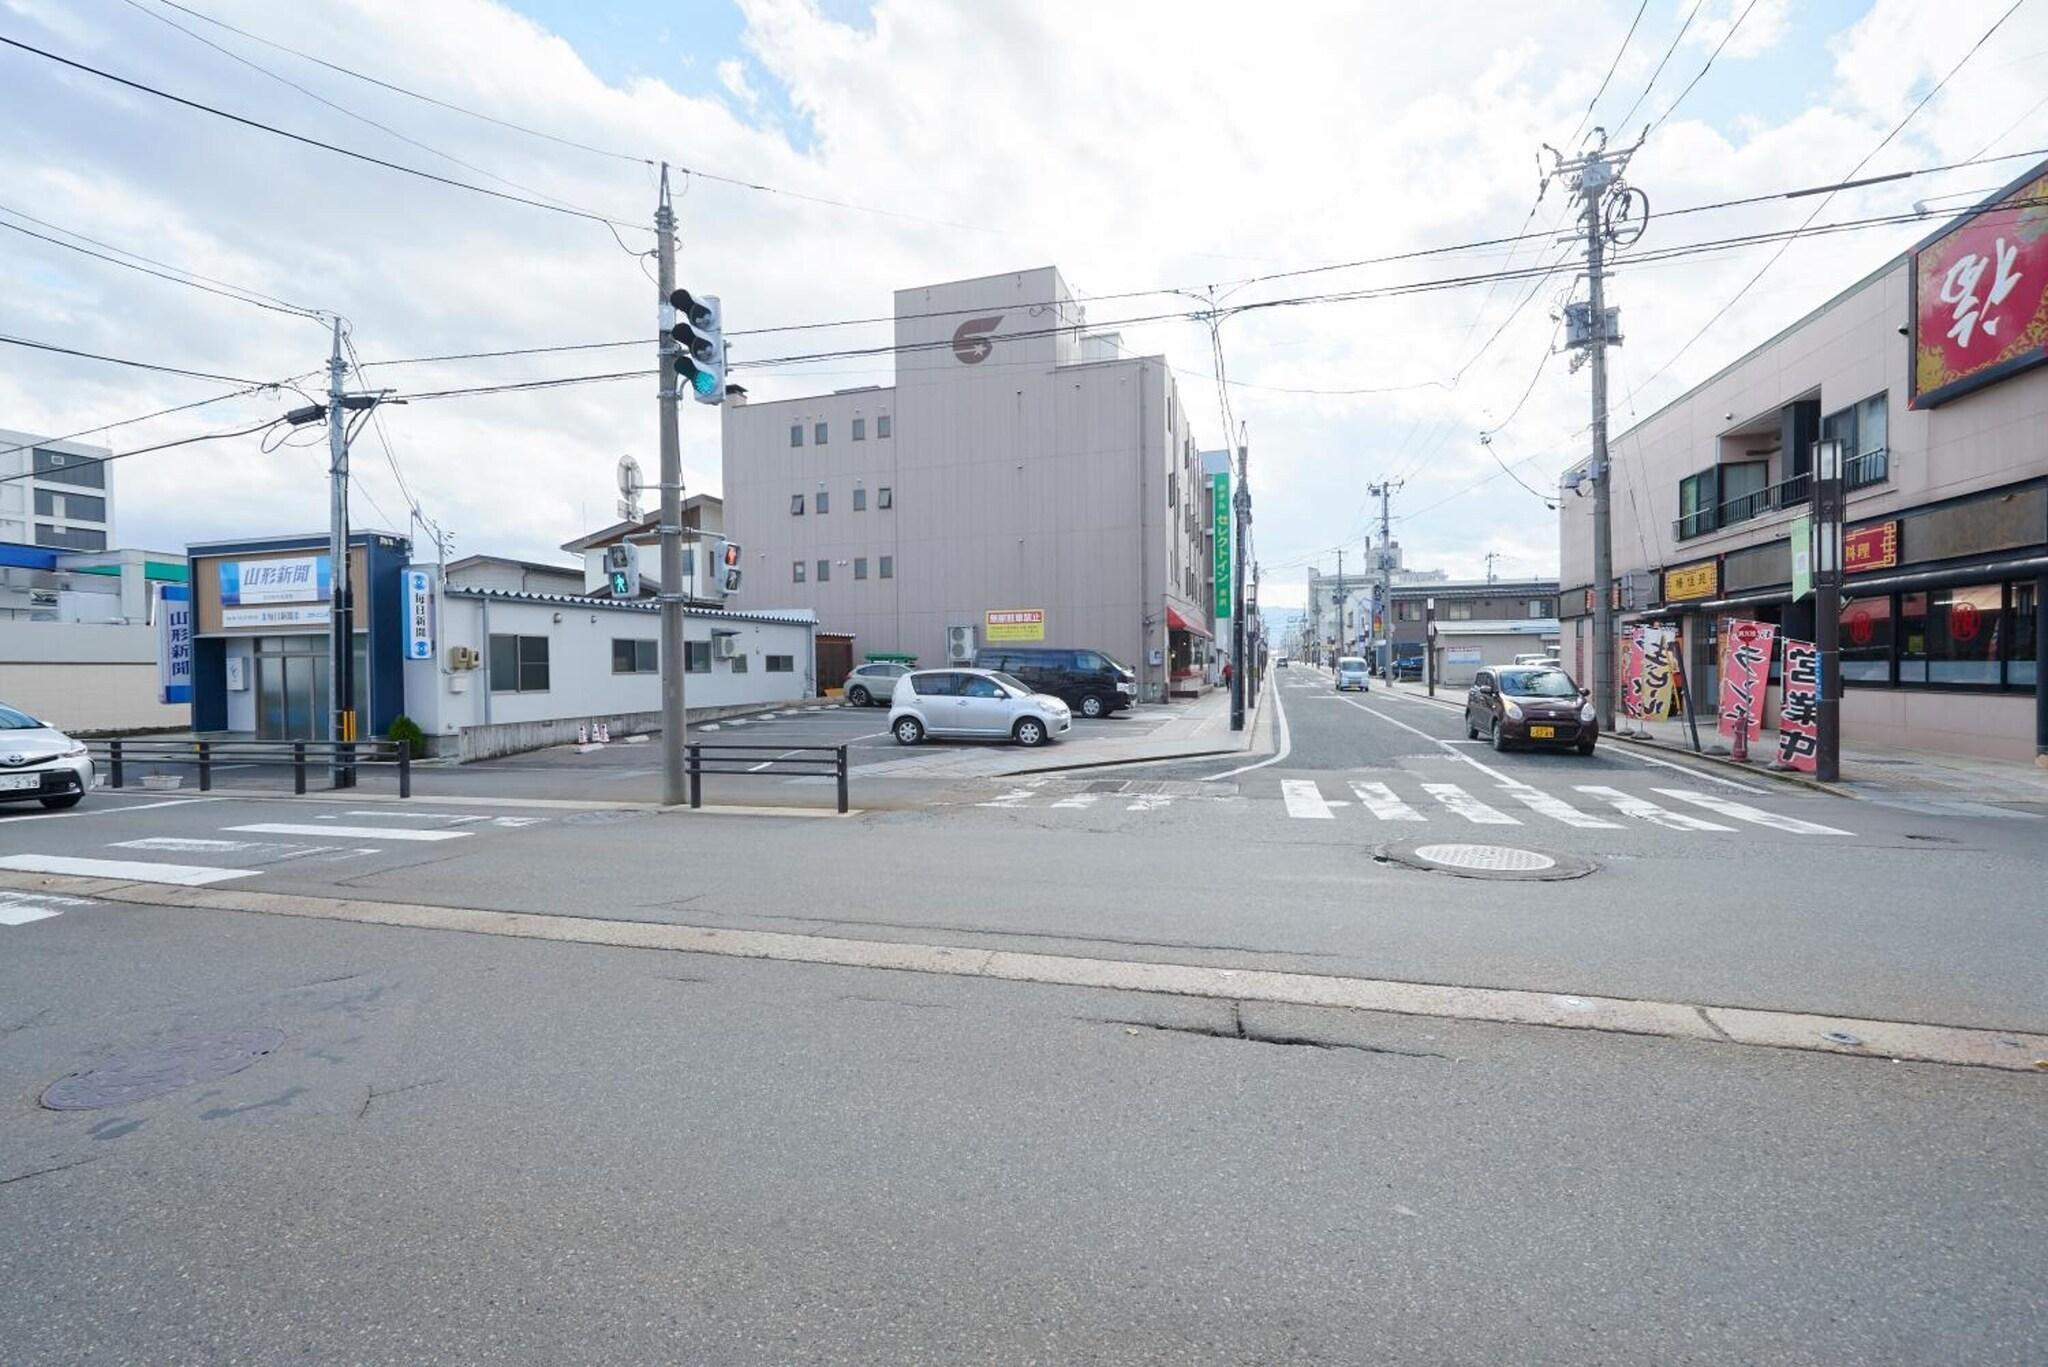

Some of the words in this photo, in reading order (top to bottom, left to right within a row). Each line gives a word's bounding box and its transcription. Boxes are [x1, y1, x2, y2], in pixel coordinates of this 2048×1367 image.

[244, 564, 312, 586] 山形新聞
[1216, 514, 1229, 583] セレクトイン
[415, 593, 426, 638] 毎日新聞
[170, 611, 190, 676] 山形新聞
